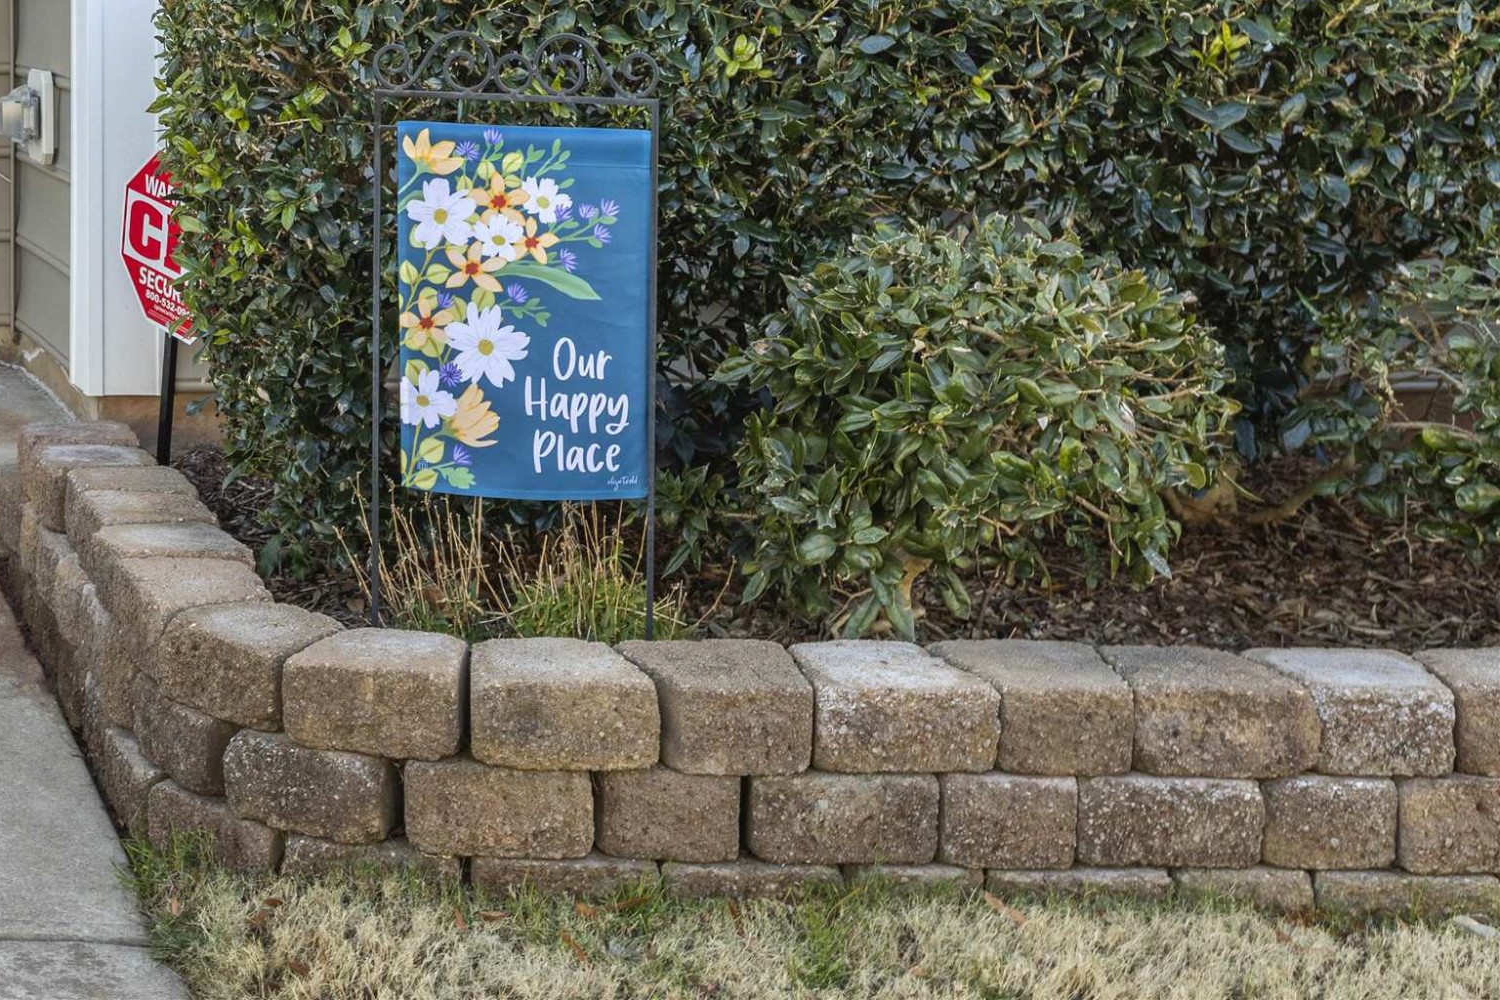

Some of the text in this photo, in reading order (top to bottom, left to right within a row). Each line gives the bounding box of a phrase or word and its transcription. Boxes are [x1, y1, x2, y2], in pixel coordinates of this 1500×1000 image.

[553, 337, 613, 381] Our
[524, 375, 630, 435] Happy
[533, 429, 621, 474] Place
